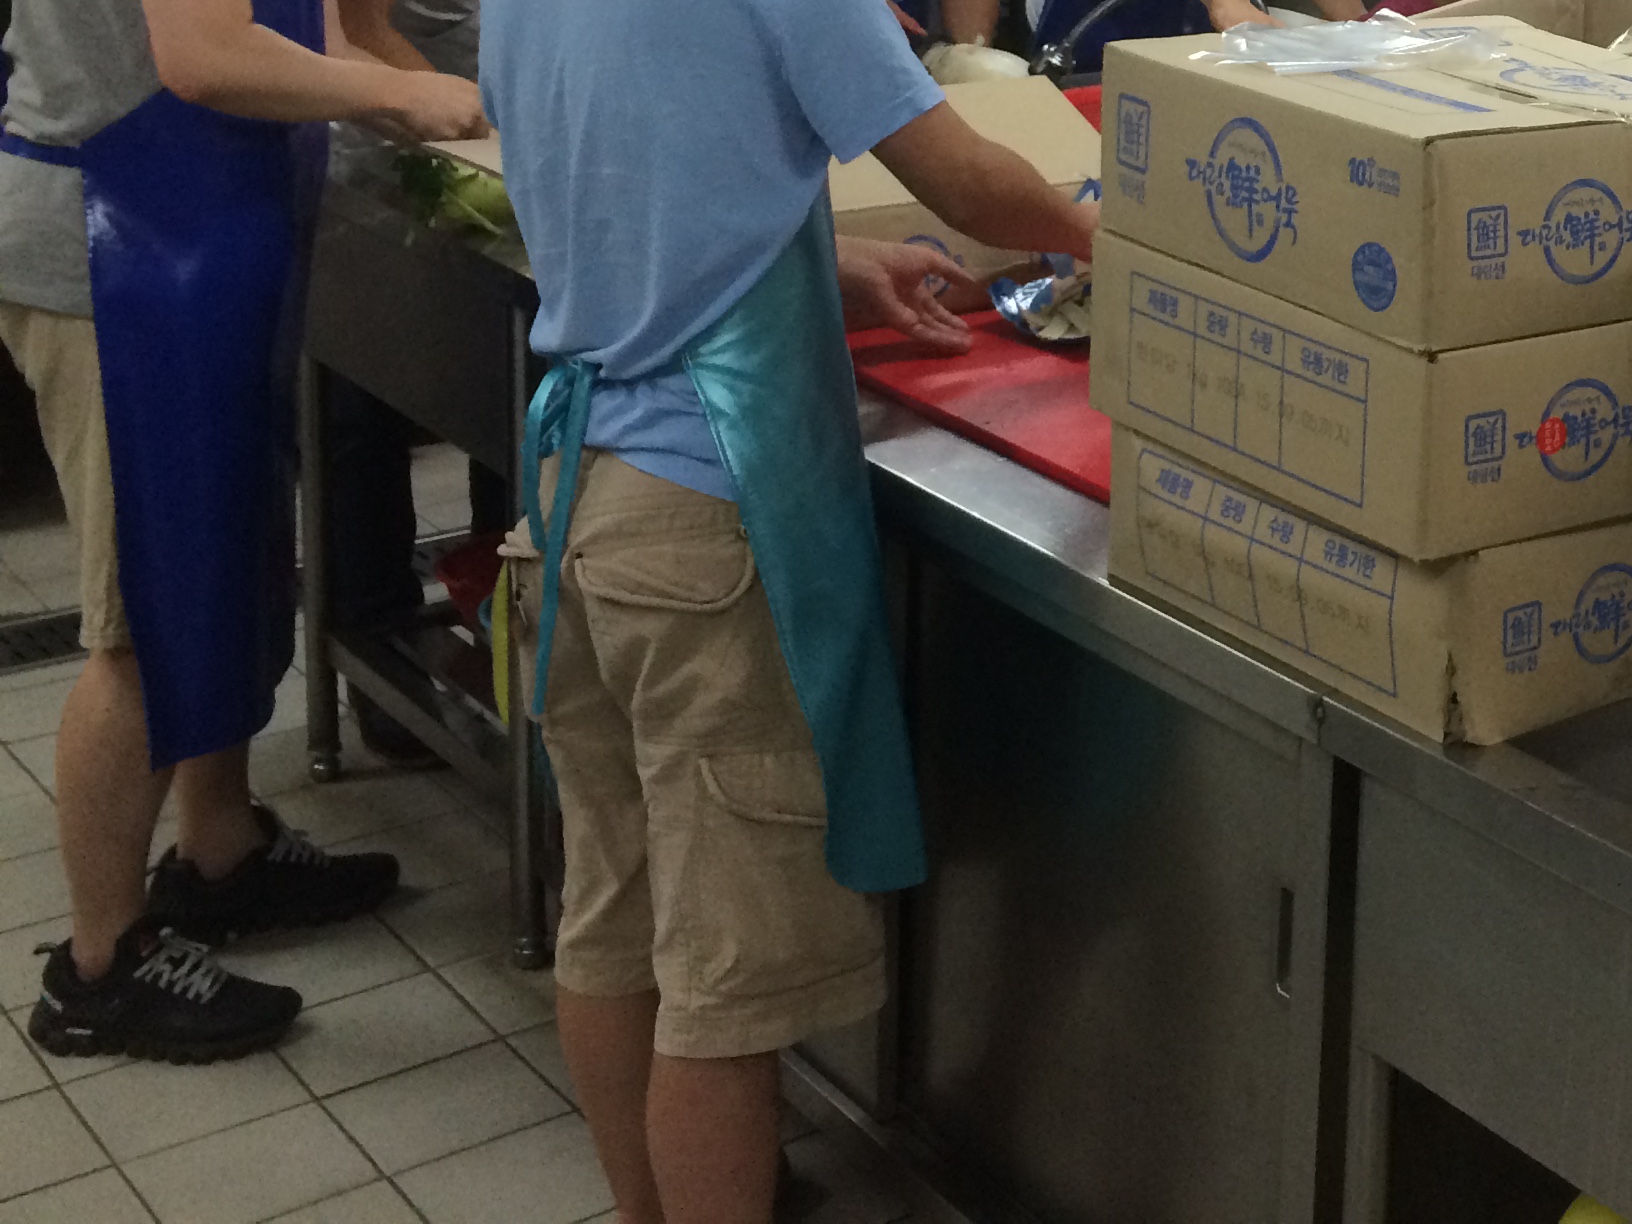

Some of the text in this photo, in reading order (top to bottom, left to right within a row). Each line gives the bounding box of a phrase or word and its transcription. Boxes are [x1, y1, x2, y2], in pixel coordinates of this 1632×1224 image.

[1301, 346, 1349, 384] 유통기한
[1269, 516, 1295, 544] 수량
[1323, 538, 1377, 579] 유통기한
